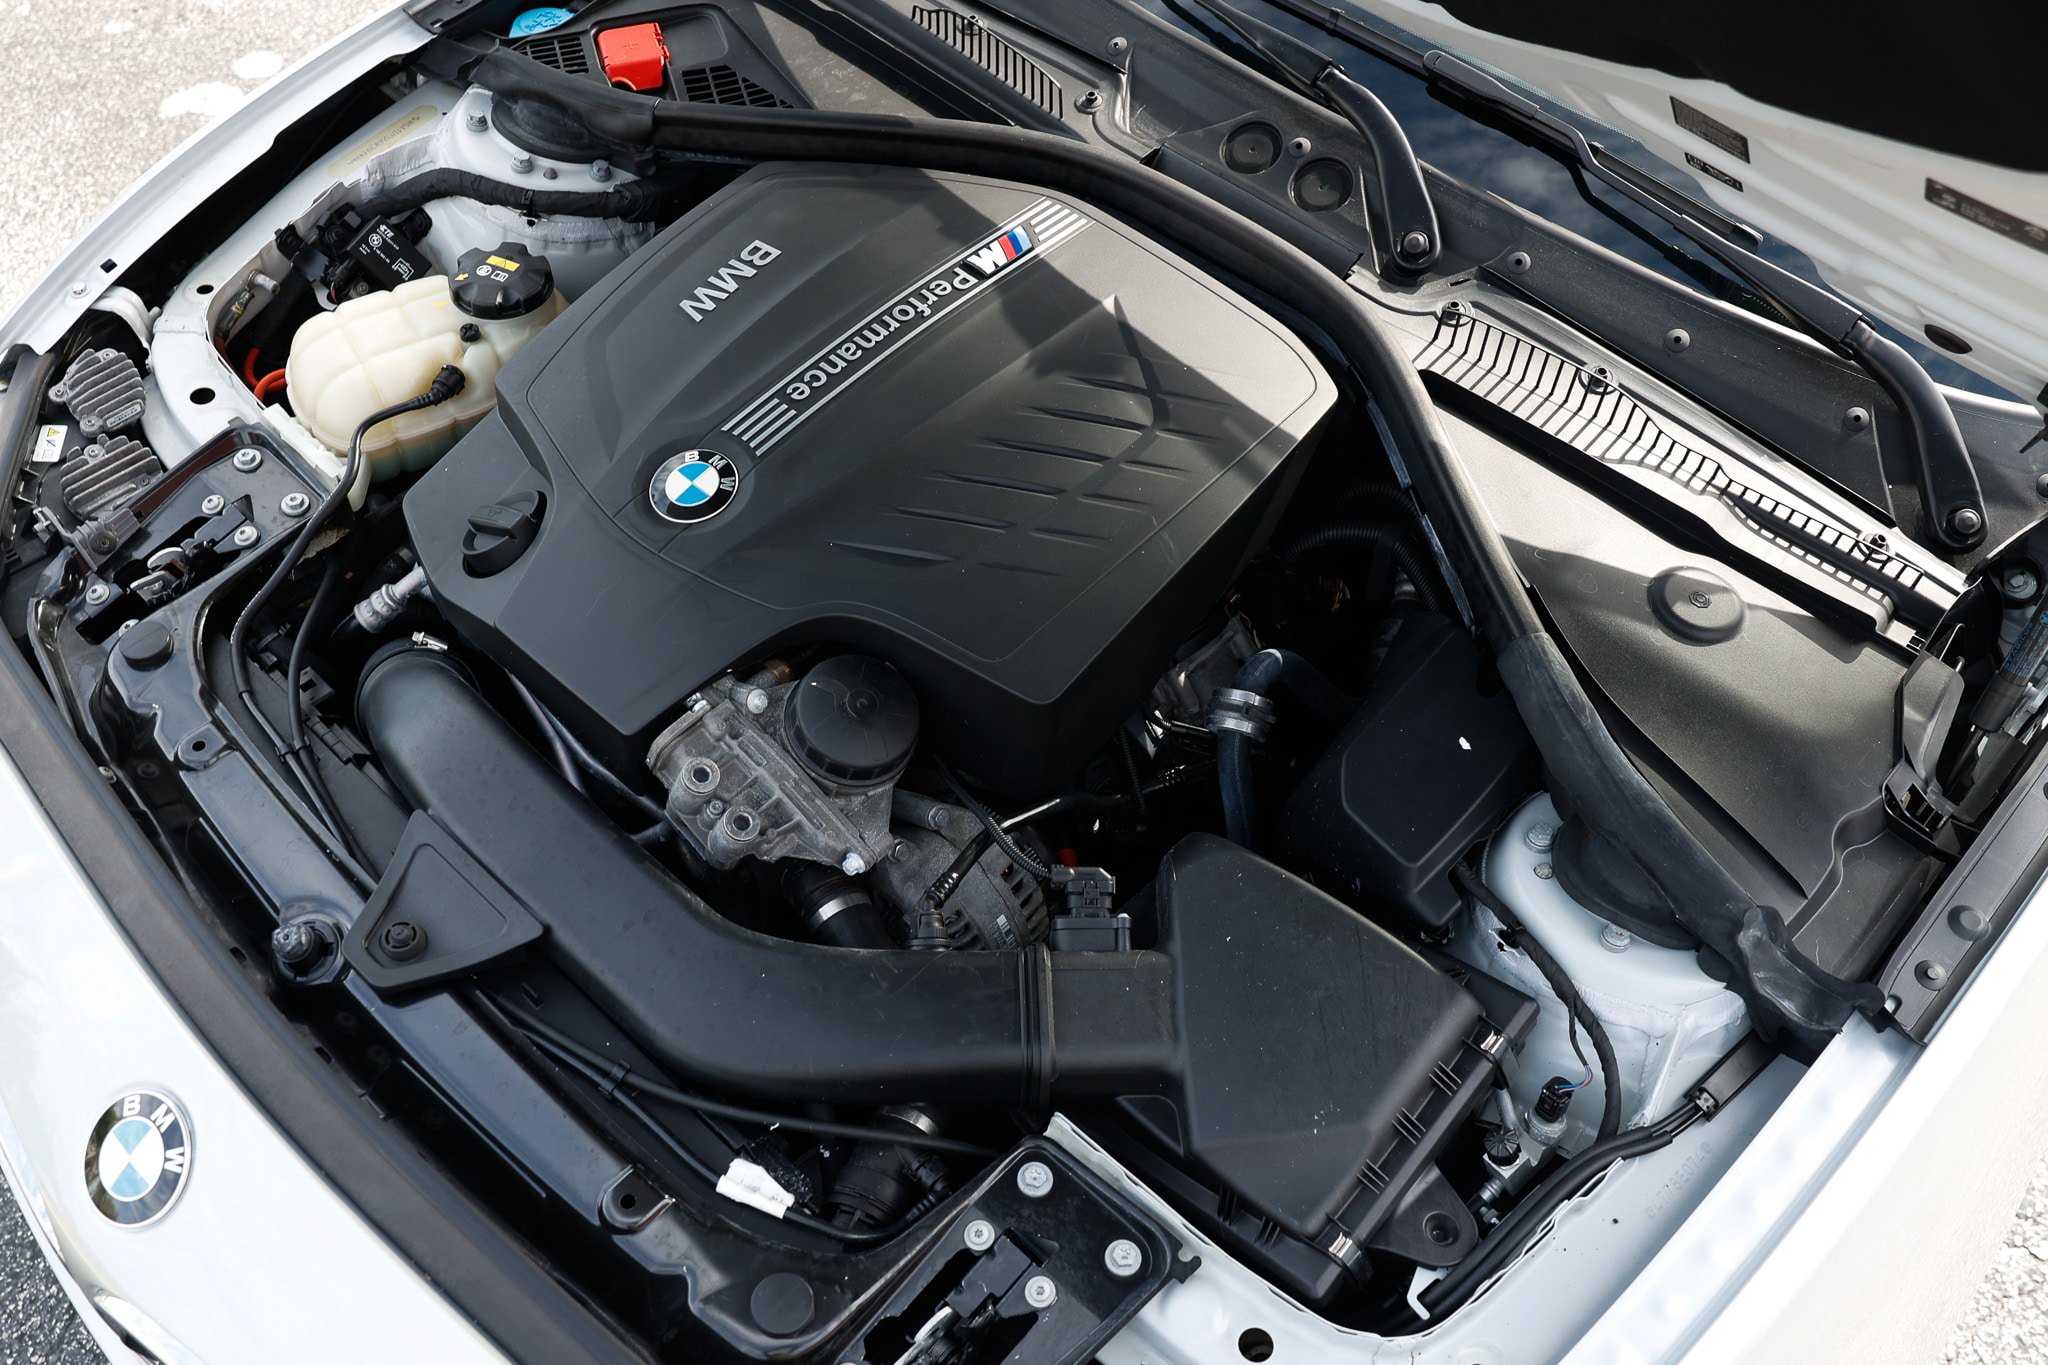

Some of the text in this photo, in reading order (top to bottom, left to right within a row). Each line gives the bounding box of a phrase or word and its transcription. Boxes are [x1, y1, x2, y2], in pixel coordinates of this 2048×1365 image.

[679, 239, 782, 323] BMW
[786, 267, 978, 400] Performance
[684, 450, 736, 491] BMW
[122, 1094, 185, 1174] BMW
